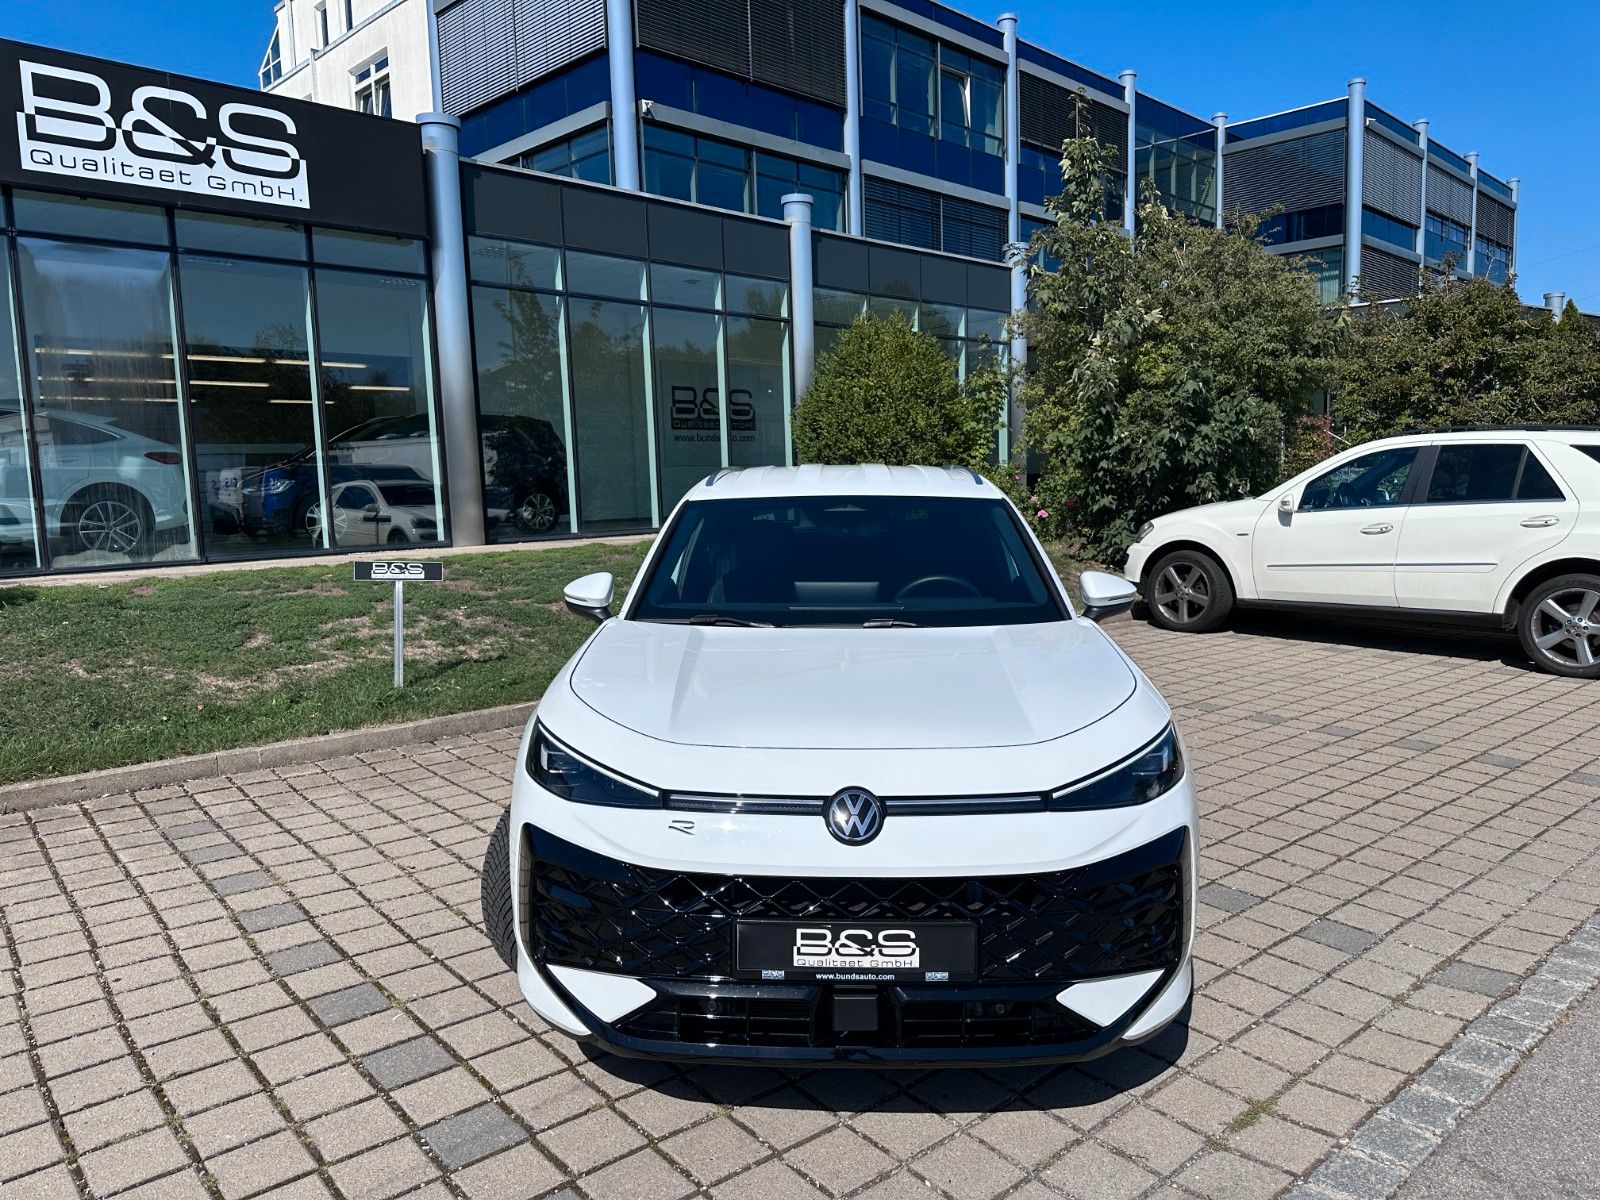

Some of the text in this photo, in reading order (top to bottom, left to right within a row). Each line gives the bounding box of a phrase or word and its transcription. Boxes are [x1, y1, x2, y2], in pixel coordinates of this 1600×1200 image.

[20, 60, 300, 179] B&S
[29, 148, 304, 202] Qualitaet GmbH.
[671, 386, 754, 419] B&S
[373, 562, 424, 575] B&S
[796, 928, 916, 957] B&S
[797, 958, 864, 967] Qualitaet
[815, 972, 895, 981] www.bundsauto.com
